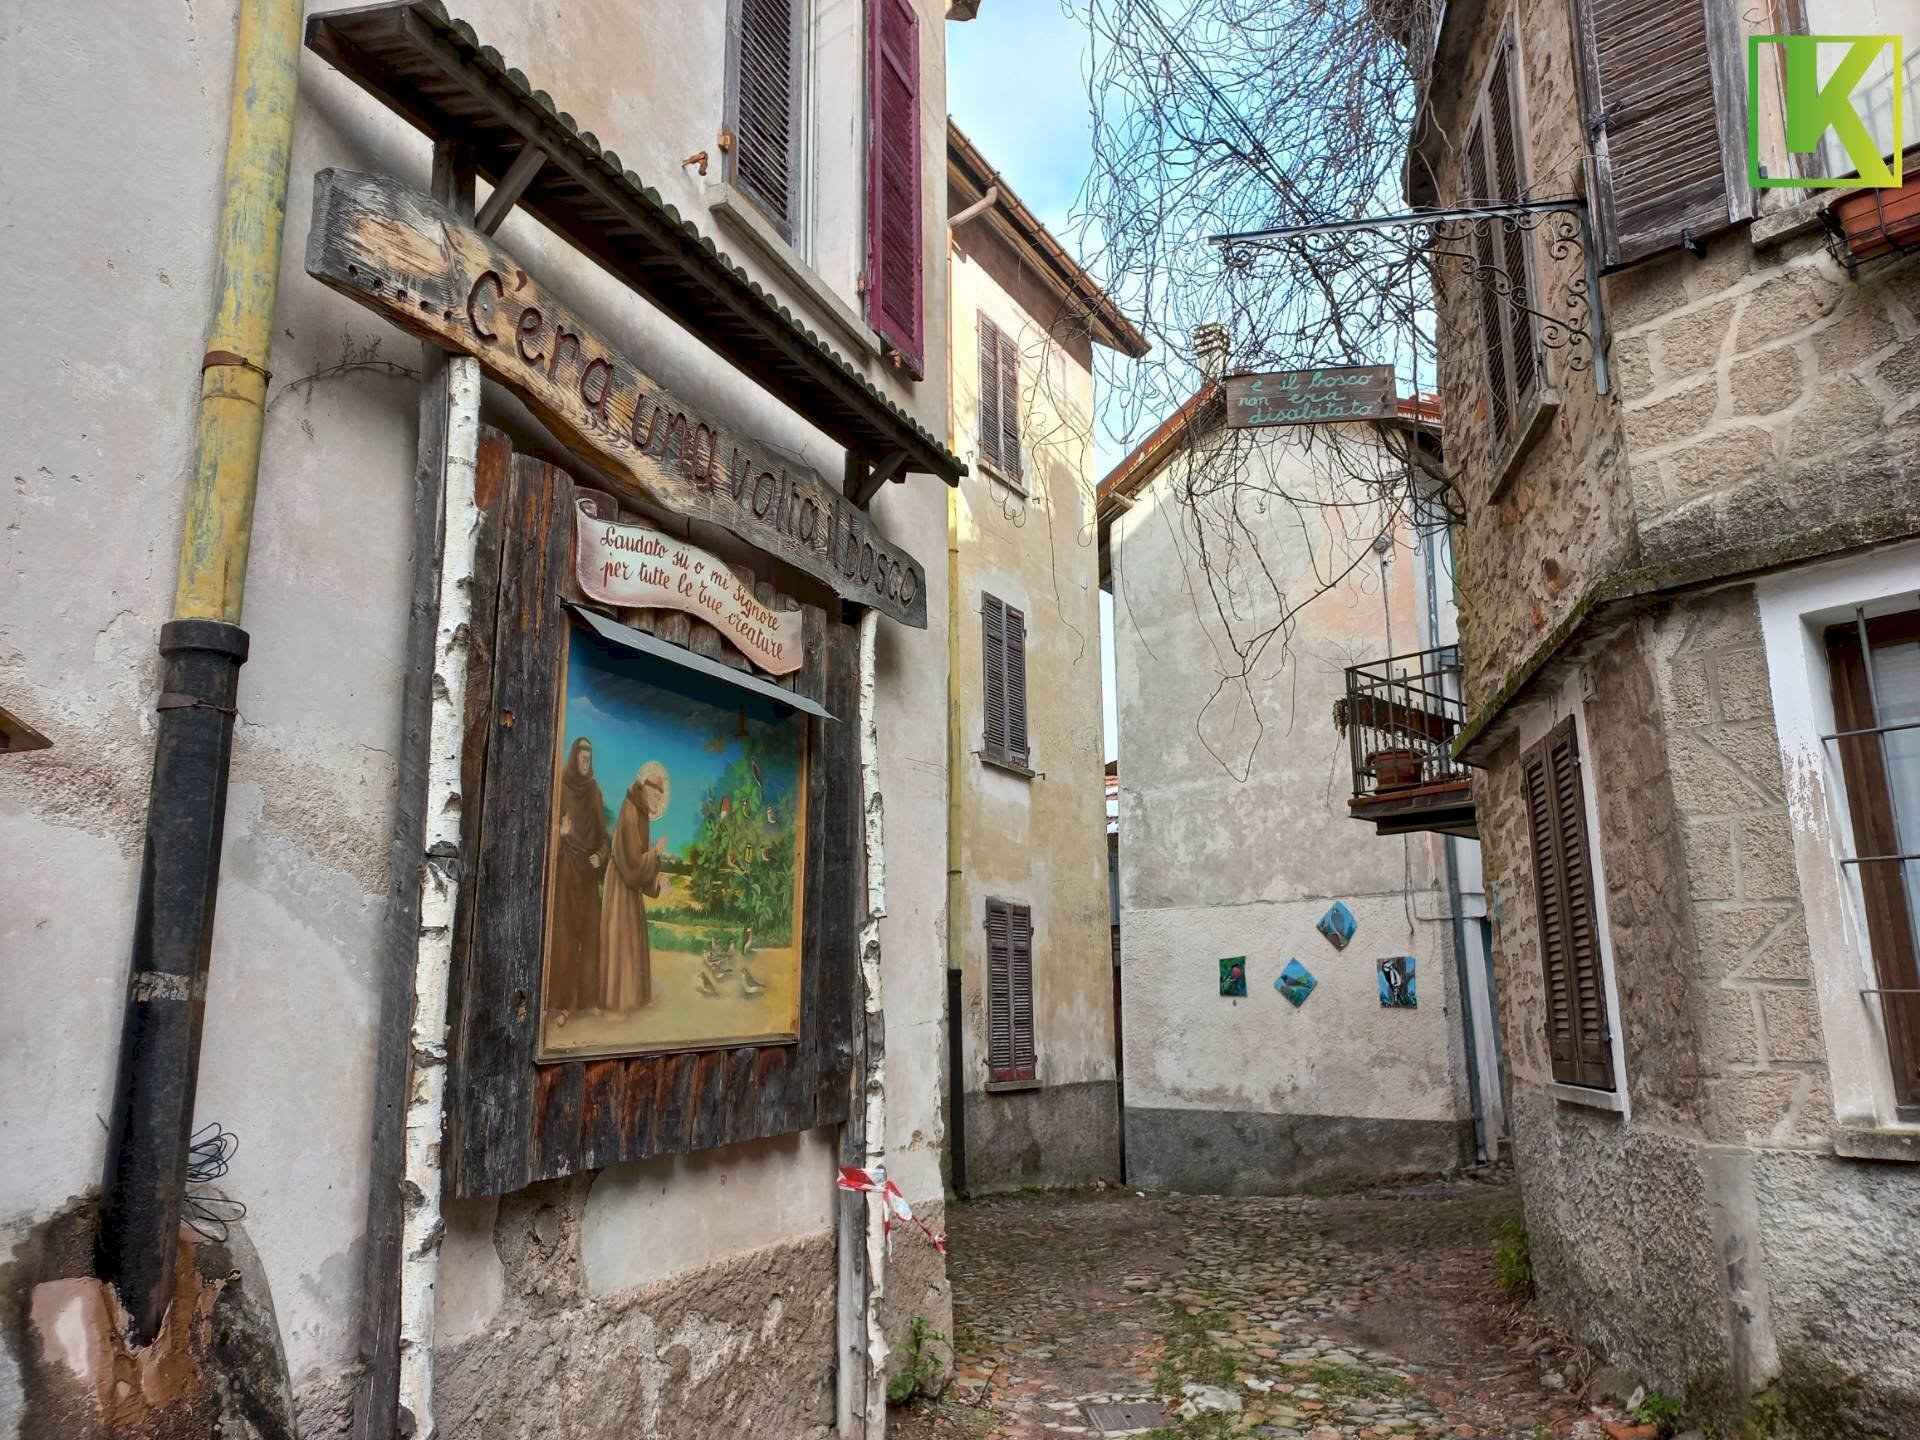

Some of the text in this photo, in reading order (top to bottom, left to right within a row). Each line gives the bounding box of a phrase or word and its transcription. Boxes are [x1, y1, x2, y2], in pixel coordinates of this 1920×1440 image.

[1238, 390, 1347, 408] non era
[1280, 372, 1301, 392] il
[1308, 371, 1374, 391] bosco
[467, 270, 613, 421] C'era
[632, 394, 717, 493] una
[731, 447, 819, 551] volta
[827, 499, 839, 568] il
[844, 513, 918, 607] bosco
[1248, 401, 1374, 424] disabitato
[600, 525, 668, 559] Laudato
[694, 561, 705, 575] o
[733, 584, 780, 631] Signore
[600, 561, 785, 660] per tutte le tue creature
